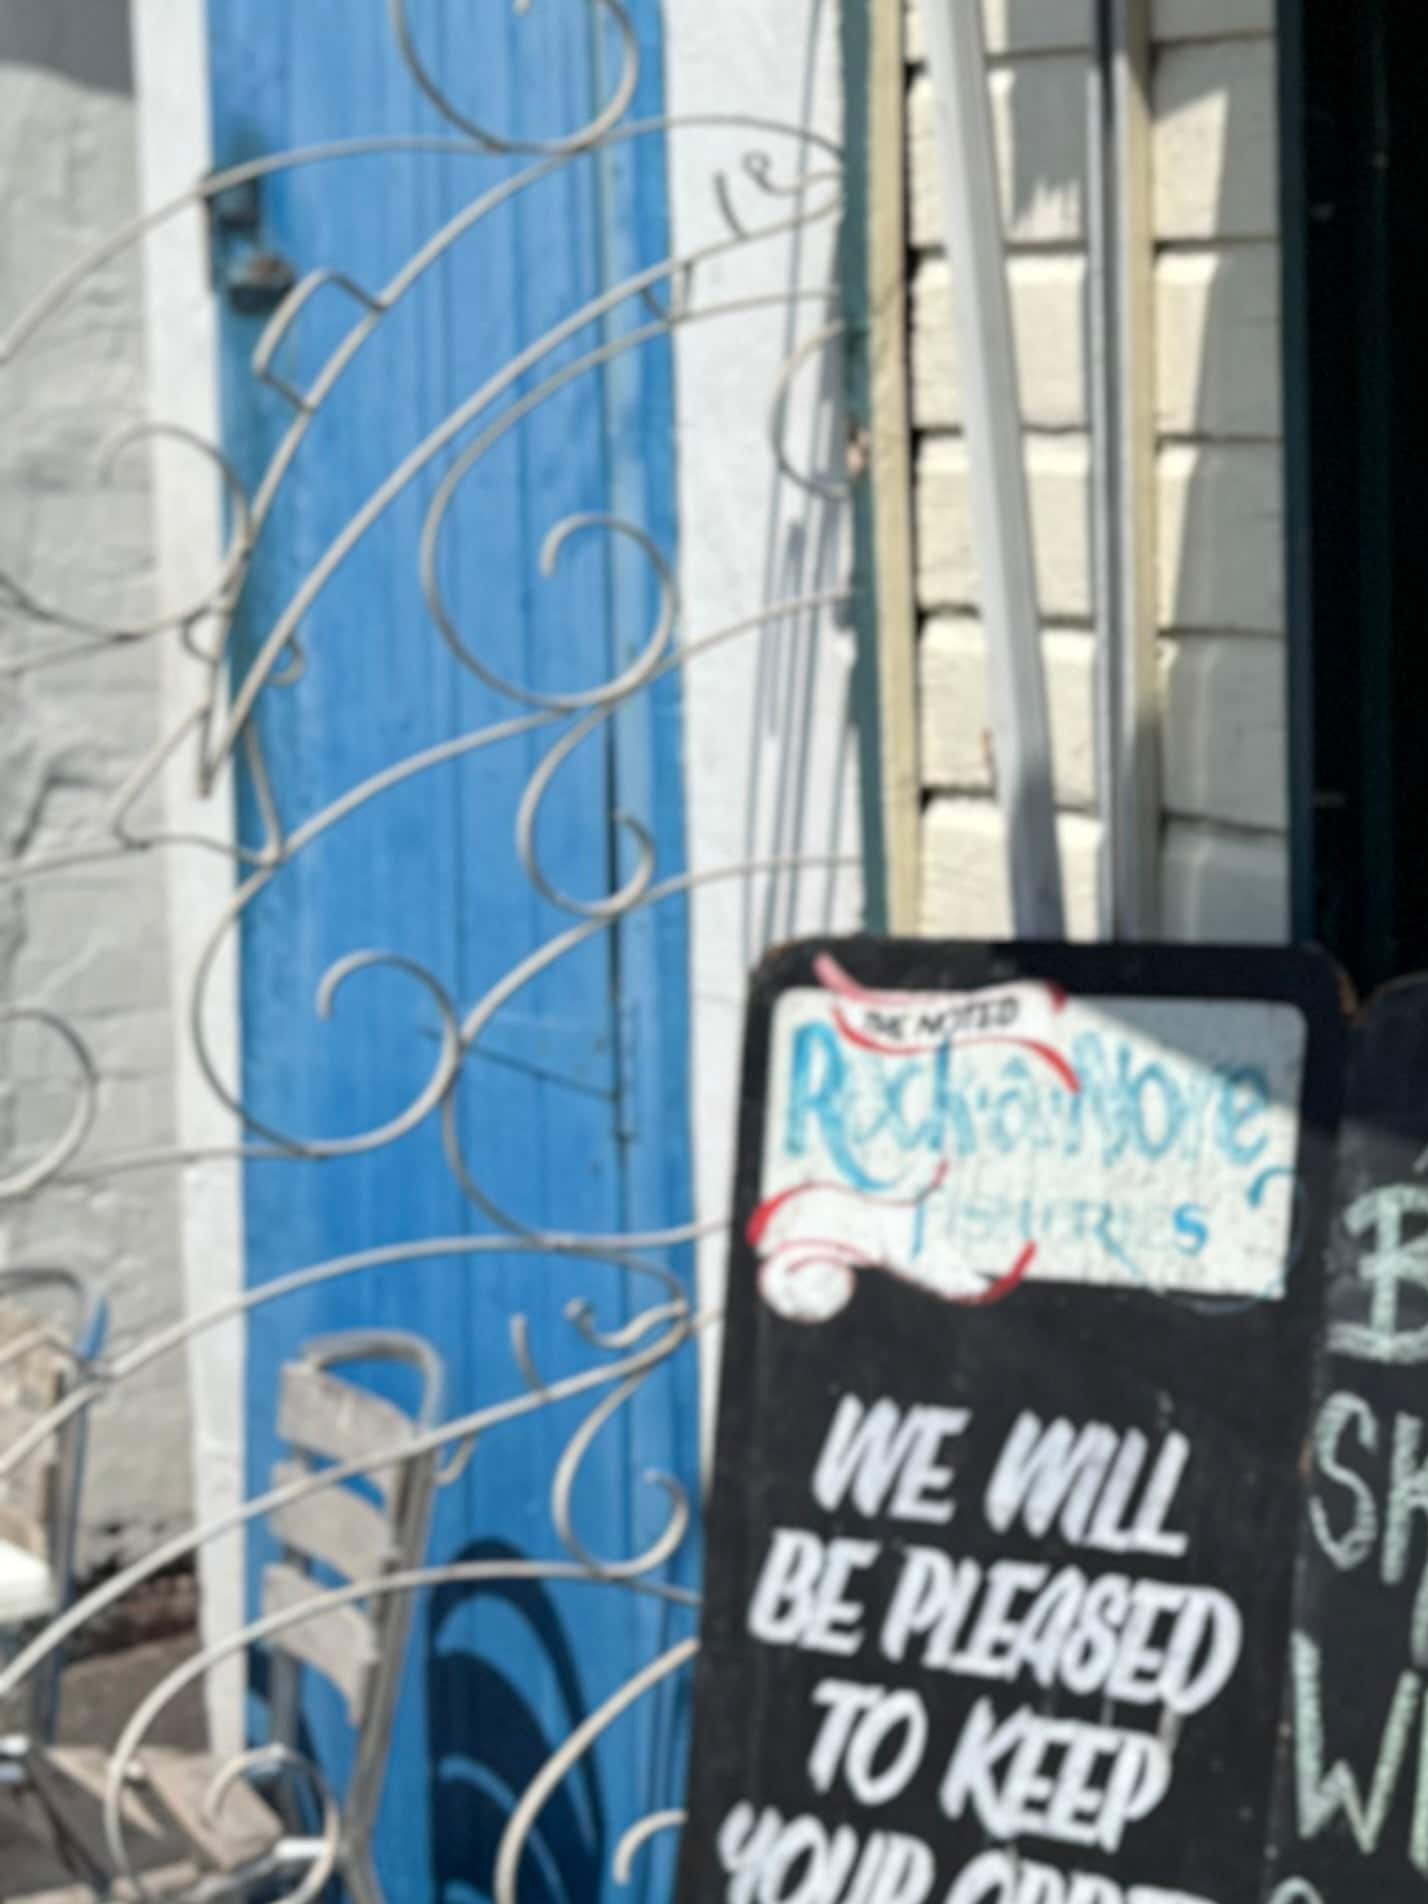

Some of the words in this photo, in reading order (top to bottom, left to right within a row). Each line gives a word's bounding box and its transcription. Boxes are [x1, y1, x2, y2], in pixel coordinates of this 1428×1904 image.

[812, 1393, 972, 1524] WE
[984, 1409, 1191, 1557] WILL
[746, 1526, 882, 1656] BE
[879, 1543, 1244, 1717] PLEASED
[807, 1678, 929, 1808] TO
[939, 1695, 1173, 1855] KEEP
